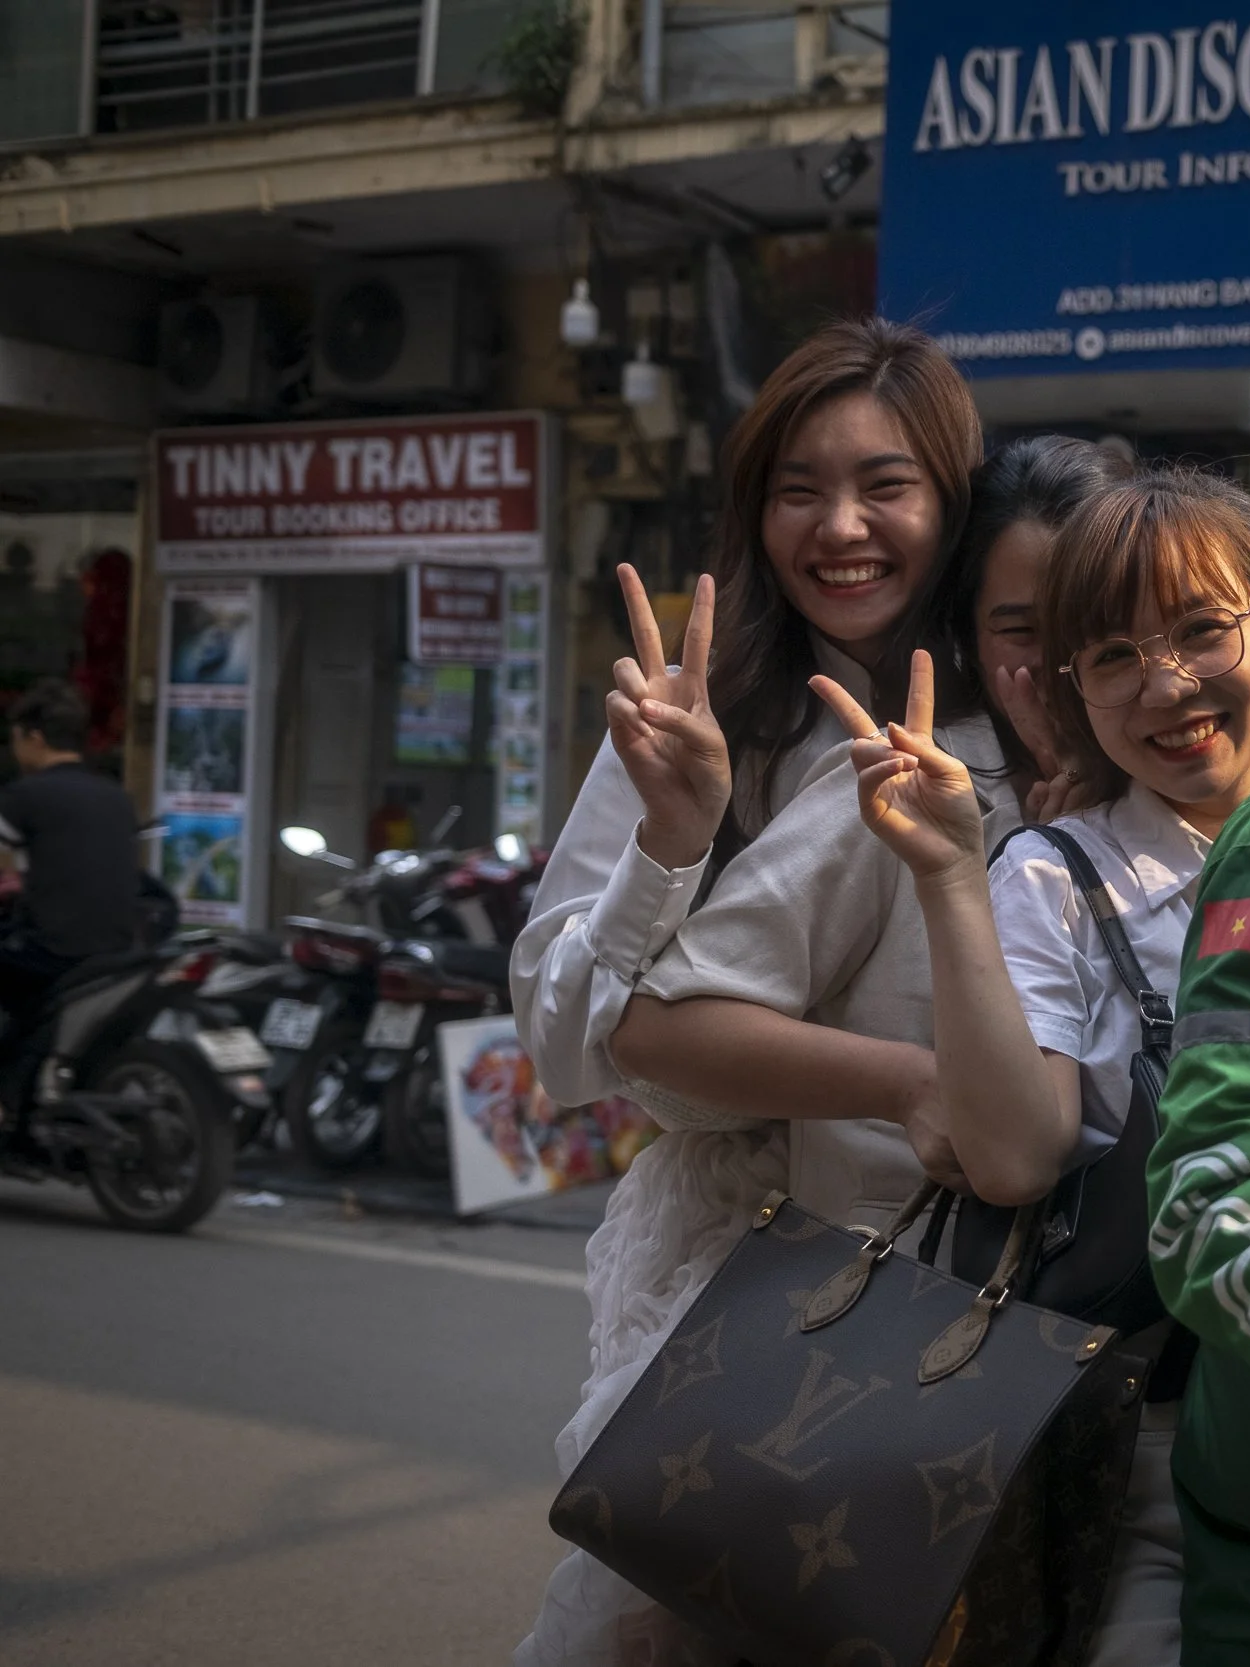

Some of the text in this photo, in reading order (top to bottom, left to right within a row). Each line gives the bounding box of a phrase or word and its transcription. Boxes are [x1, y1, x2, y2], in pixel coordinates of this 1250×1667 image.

[914, 38, 1117, 152] ASIAN
[1058, 158, 1168, 196] TOUR
[166, 430, 531, 498] TINNY TRAVEL
[193, 497, 502, 536] TOUR BOOKING OFFICE
